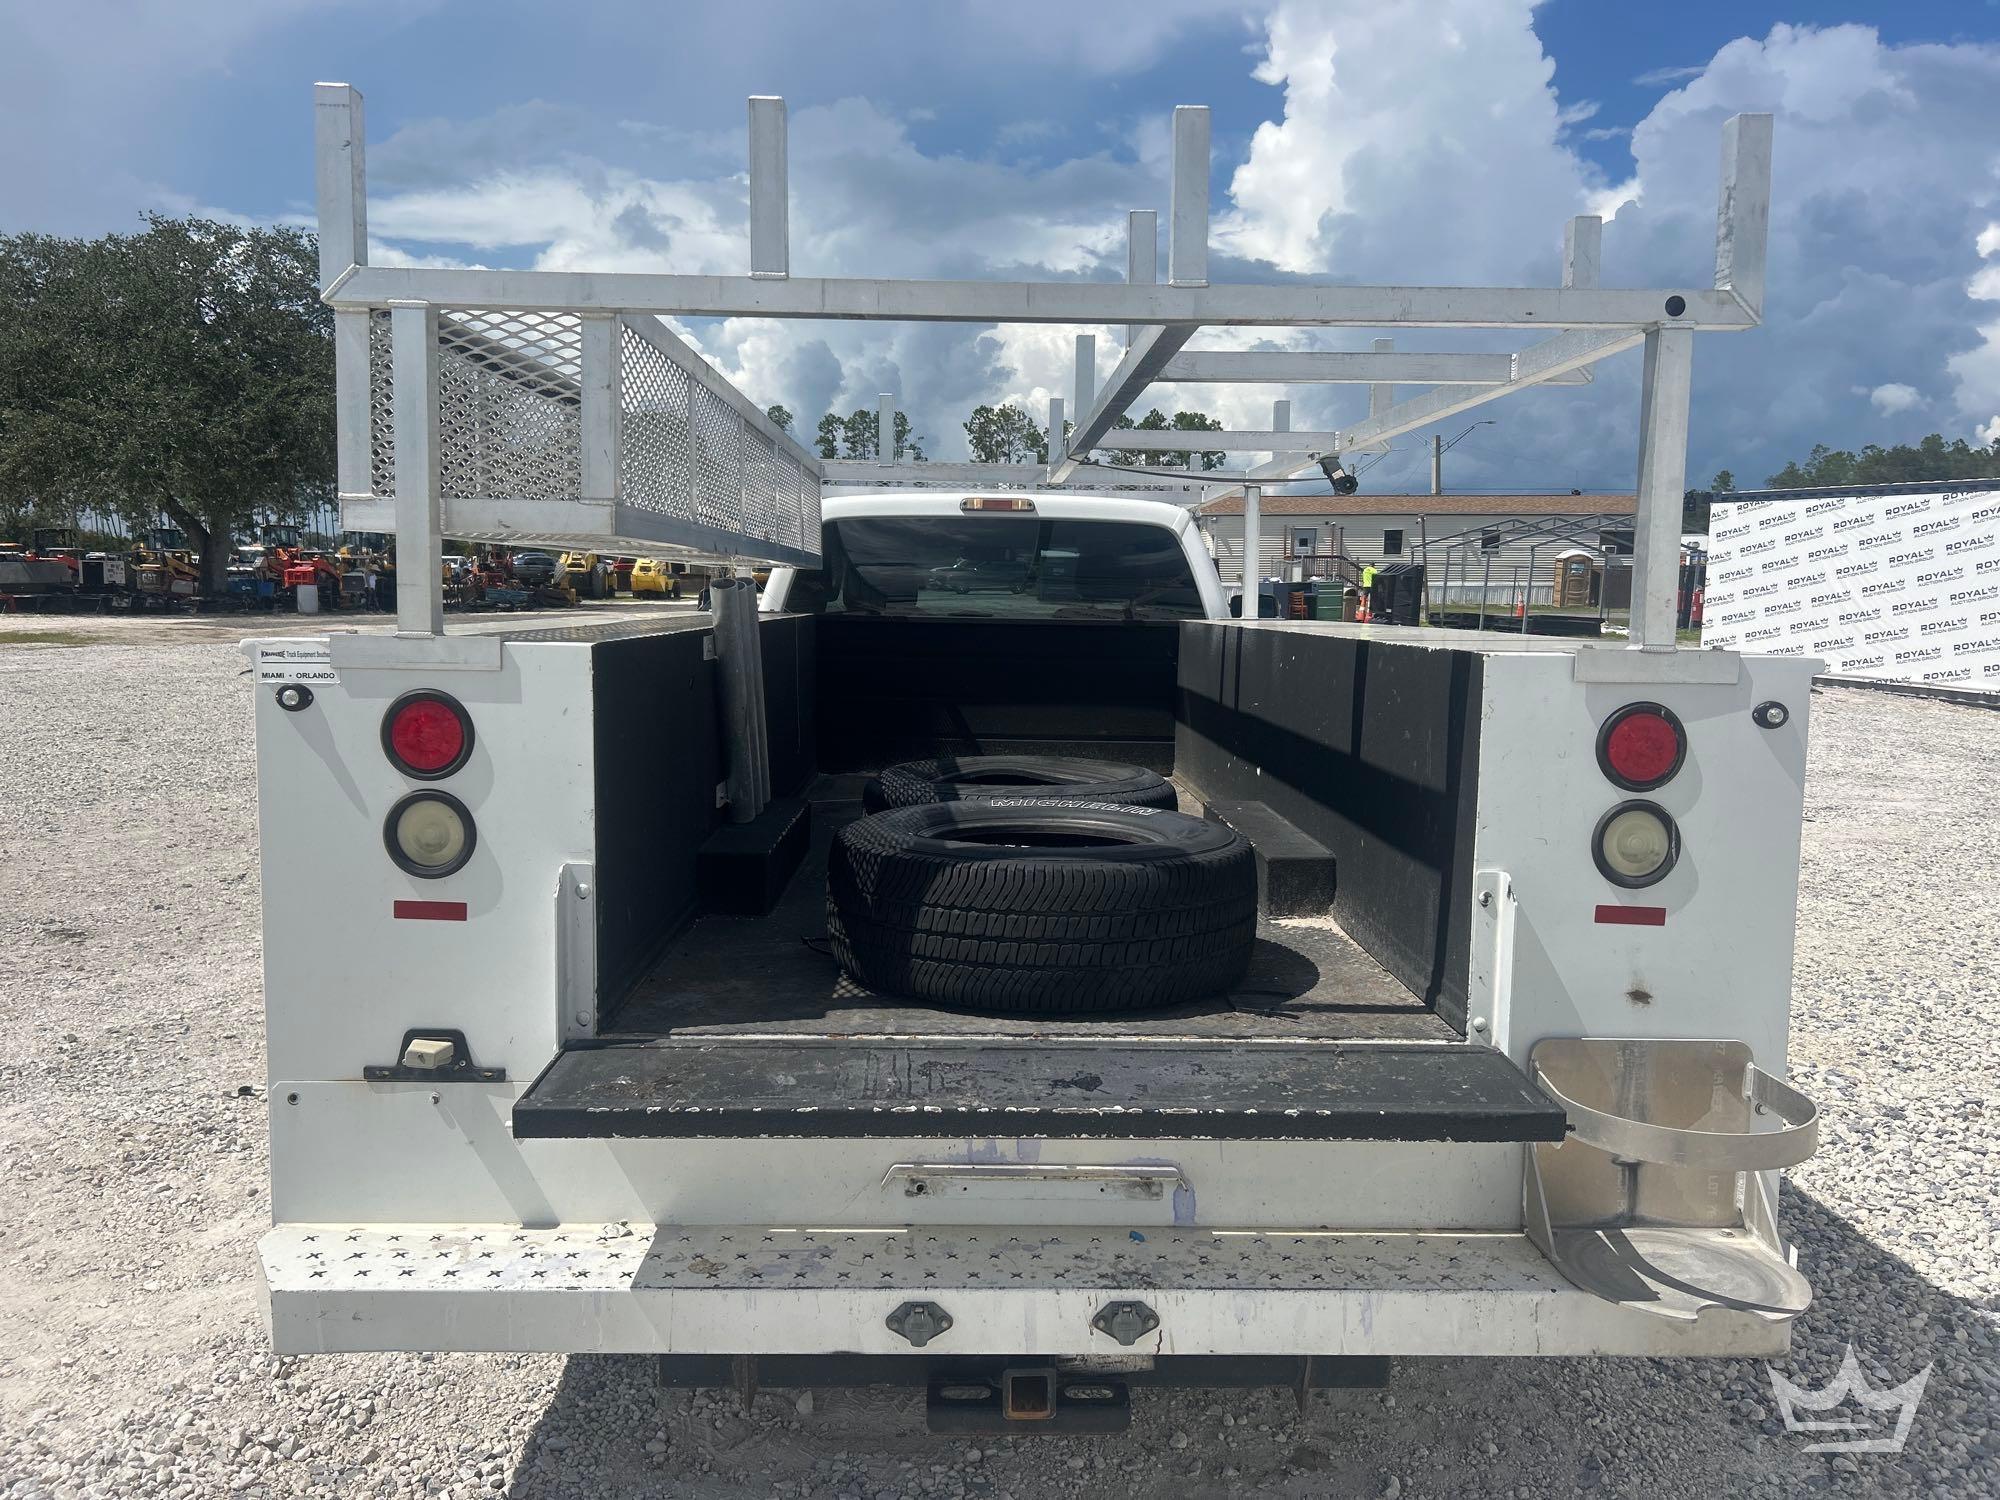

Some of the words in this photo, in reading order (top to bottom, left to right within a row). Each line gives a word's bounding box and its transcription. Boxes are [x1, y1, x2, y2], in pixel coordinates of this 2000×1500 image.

[1806, 501, 1836, 513] ROYAL
[1885, 502, 1920, 516] ROYAL
[1759, 514, 1787, 526] ROYAL
[1833, 516, 1865, 529] ROYAL
[1716, 527, 1742, 538] ROYAL
[1913, 520, 1948, 534] ROYAL
[1784, 529, 1814, 542] ROYAL
[1858, 534, 1891, 546] ROYAL
[1740, 542, 1767, 553] ROYAL
[1945, 537, 1983, 551] ROYAL
[1808, 546, 1839, 558] ROYAL
[1889, 551, 1923, 564] ROYAL
[1761, 558, 1790, 570] ROYAL
[1836, 563, 1868, 575] ROYAL
[1719, 569, 1745, 580] ROYAL
[1787, 575, 1817, 586] ROYAL
[1917, 570, 1953, 582] ROYAL
[1743, 585, 1770, 596] ROYAL
[1861, 581, 1895, 593] ROYAL
[1811, 592, 1842, 604] ROYAL
[1950, 588, 1987, 601] ROYAL
[1764, 602, 1793, 613] ROYAL
[1892, 600, 1927, 612] ROYAL
[1721, 612, 1748, 622] ROYAL
[1839, 610, 1871, 621] ROYAL
[1790, 620, 1820, 630] ROYAL
[1920, 620, 1957, 631] ROYAL
[1745, 629, 1772, 638] ROYAL
[1864, 630, 1898, 640] ROYAL
[1703, 637, 1729, 647] ROYAL
[1814, 638, 1845, 649] ROYAL
[1954, 639, 1992, 651] ROYAL
[1895, 649, 1930, 660] ROYAL
[1841, 657, 1874, 667] ROYAL
[1923, 669, 1961, 680] ROYAL
[991, 799, 1161, 816] MICHELIN
